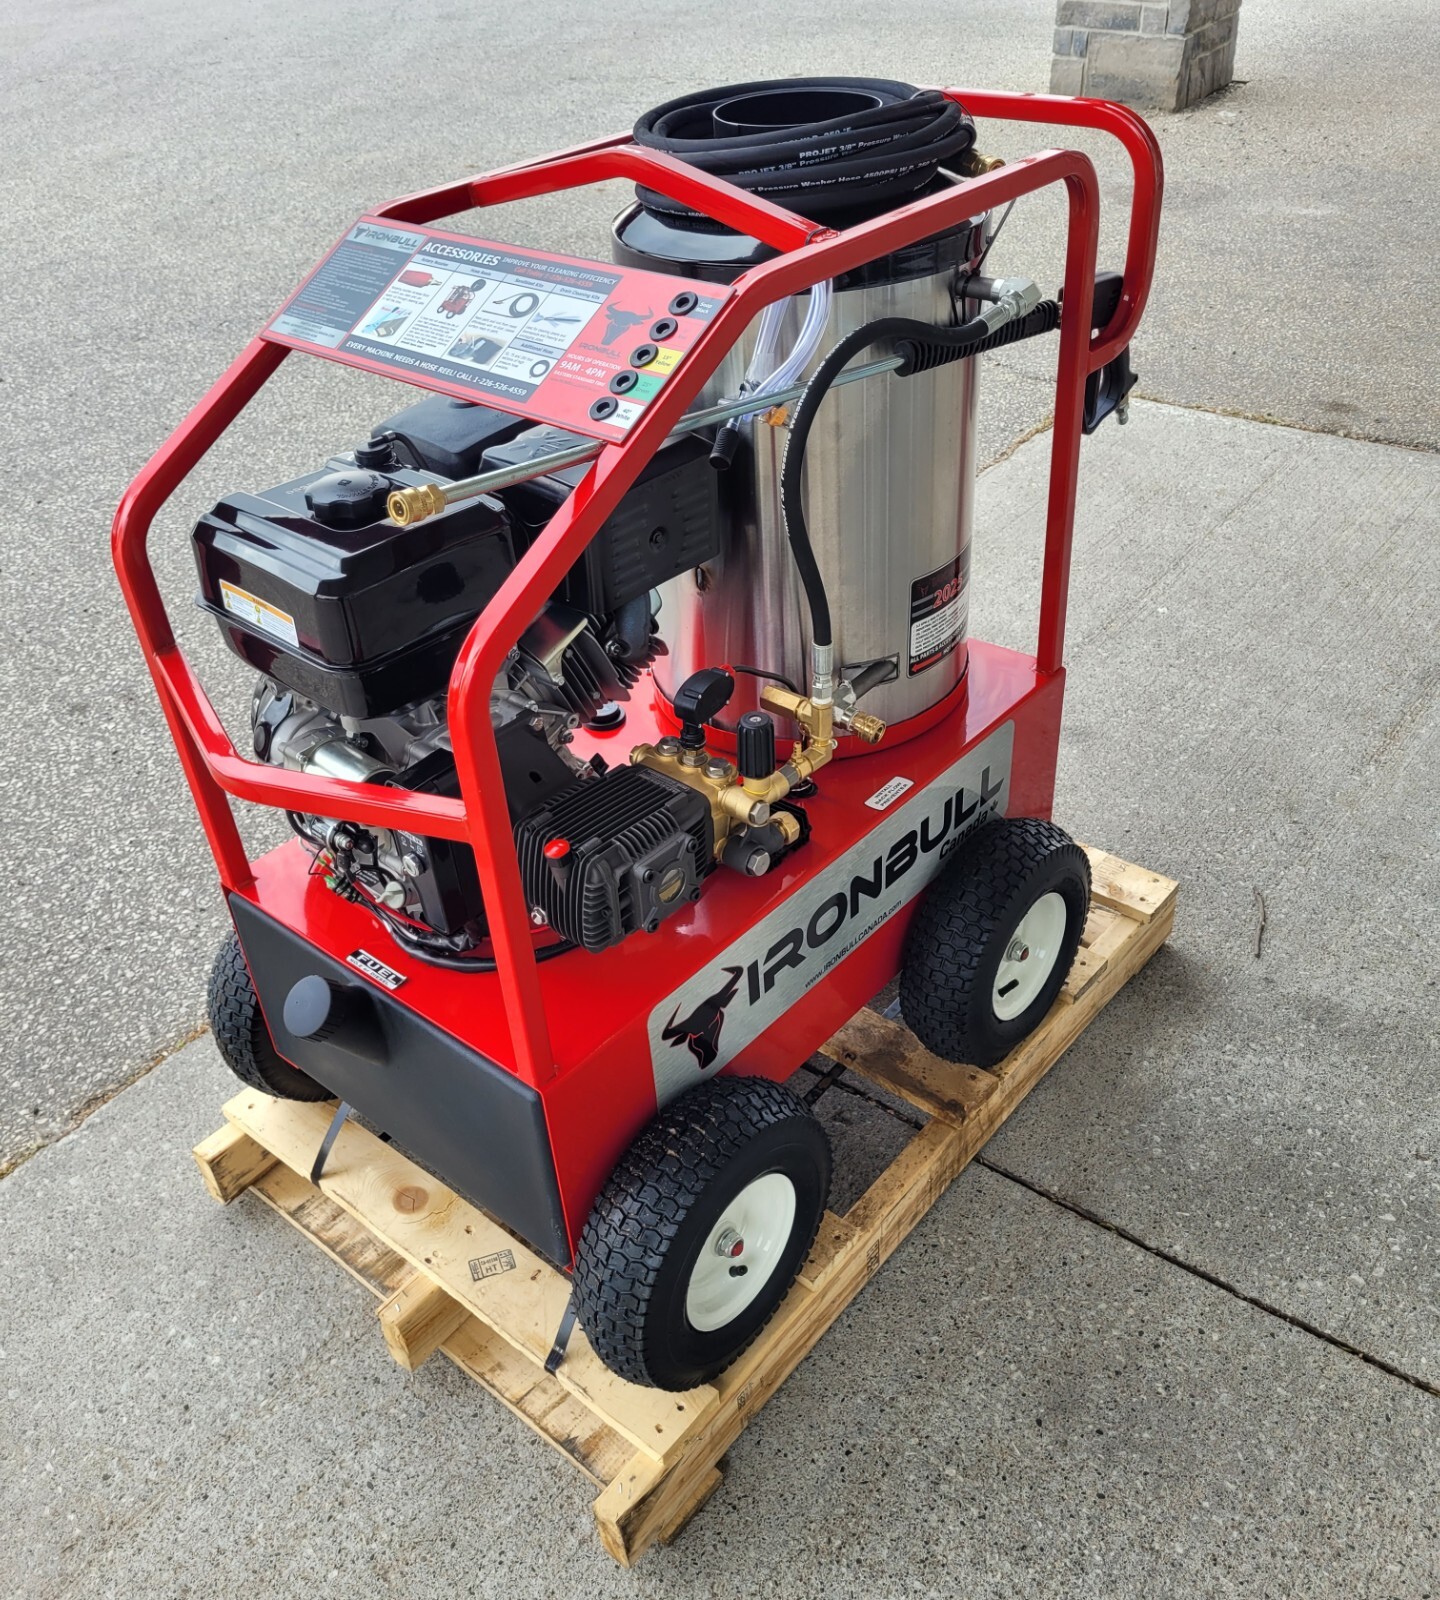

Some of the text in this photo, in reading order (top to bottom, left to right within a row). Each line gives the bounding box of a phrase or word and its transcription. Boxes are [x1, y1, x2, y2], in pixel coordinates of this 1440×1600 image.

[799, 147, 837, 159] PROJET
[858, 137, 892, 149] Pressure
[799, 153, 839, 167] Pressure
[757, 184, 799, 192] Pressure
[801, 178, 836, 187] Washer
[838, 175, 861, 183] Hose
[366, 228, 418, 248] IRONBULL
[422, 242, 500, 266] ACCESSORIES
[502, 256, 530, 268] IMPROVE
[530, 262, 547, 271] YOUR
[547, 266, 578, 278] CLEANING
[579, 271, 617, 286] EFFICIENCY
[345, 340, 528, 396] EVERY MACHINE NEEDS A HOSE REEL! CALL 1-226-526-4559
[560, 360, 582, 374] 9AM
[585, 366, 607, 379] 4PM
[592, 359, 622, 371] OPERATION
[615, 412, 631, 421] White
[939, 809, 989, 861] Canada
[746, 765, 1005, 1007] IRONBULL
[805, 900, 902, 989] www.IRONBULLCANADA.com
[357, 954, 397, 985] FUEL
[485, 1263, 498, 1274] HT
